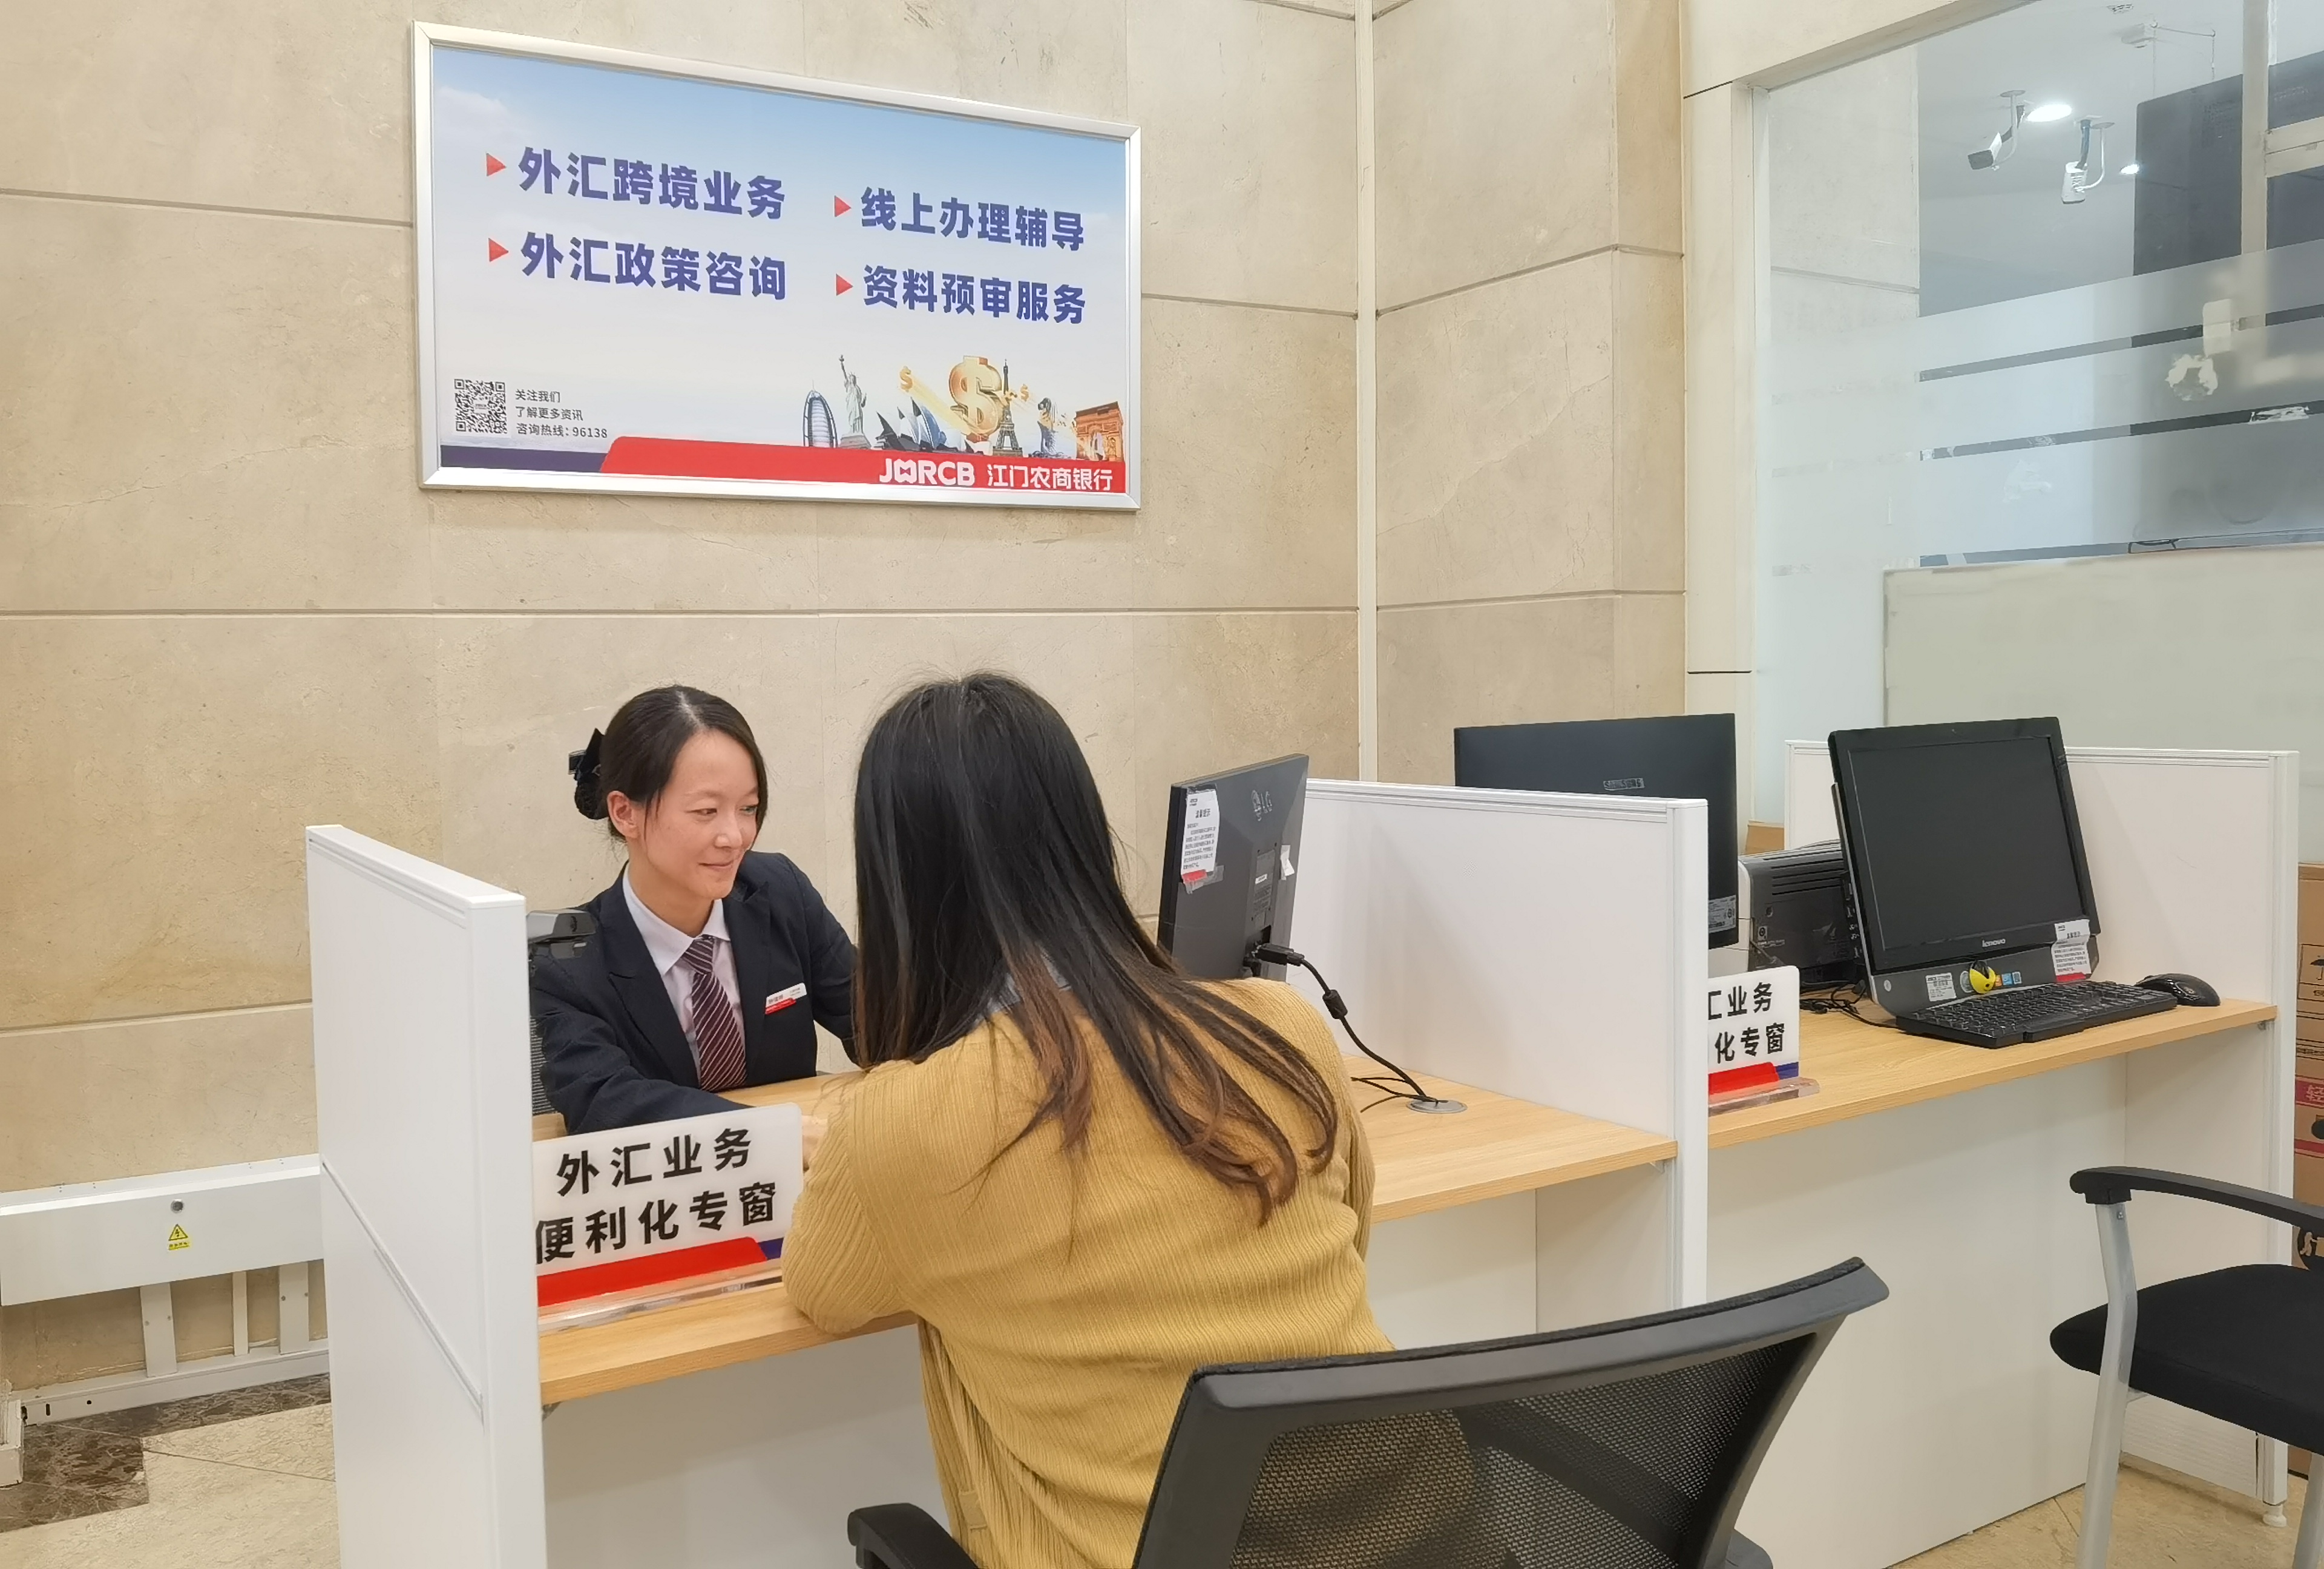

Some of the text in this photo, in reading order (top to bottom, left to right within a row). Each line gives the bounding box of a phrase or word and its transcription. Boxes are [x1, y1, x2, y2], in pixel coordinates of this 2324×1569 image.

[518, 146, 785, 219] 外汇跨境业务
[861, 186, 1084, 251] 线上办理辅导
[520, 231, 786, 300] 外汇政策咨询
[863, 265, 1085, 324] 资料预审服务
[515, 389, 561, 403] 关注我们
[515, 406, 583, 421] 了解更多资讯
[987, 464, 1113, 491] 江门农商银行
[1715, 1022, 1785, 1064] 化专窗
[556, 1128, 751, 1197] 外汇业务
[536, 1182, 776, 1265] 便利化专窗
